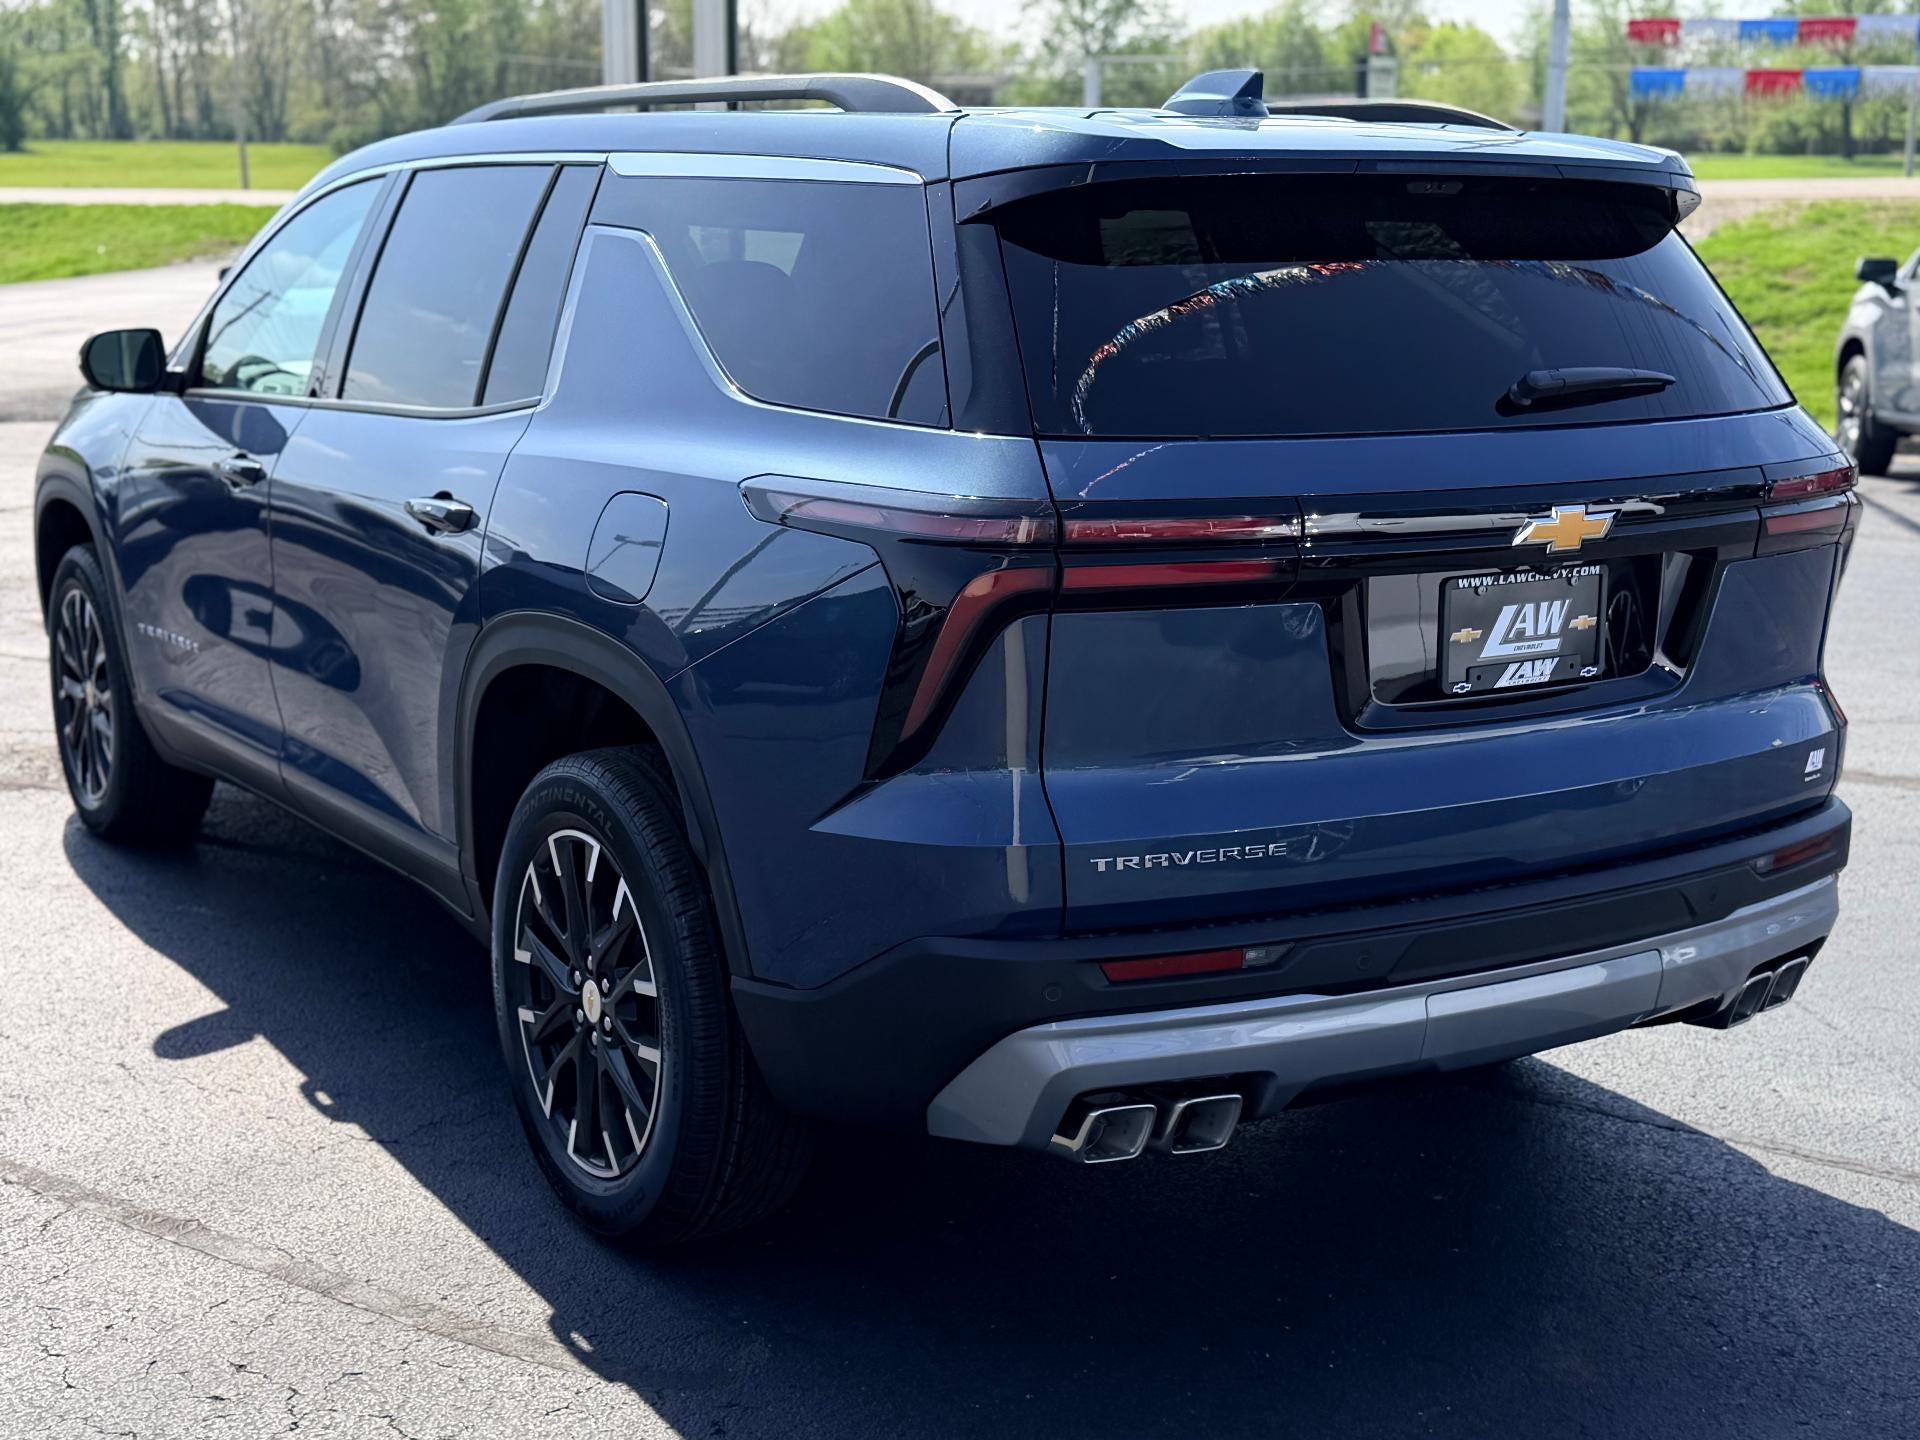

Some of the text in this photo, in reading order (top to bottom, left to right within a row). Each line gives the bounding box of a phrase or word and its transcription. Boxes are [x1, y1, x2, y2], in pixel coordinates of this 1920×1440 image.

[1480, 600, 1571, 659] LAW
[1493, 657, 1560, 688] LAW
[1090, 842, 1288, 872] TRAVERSE
